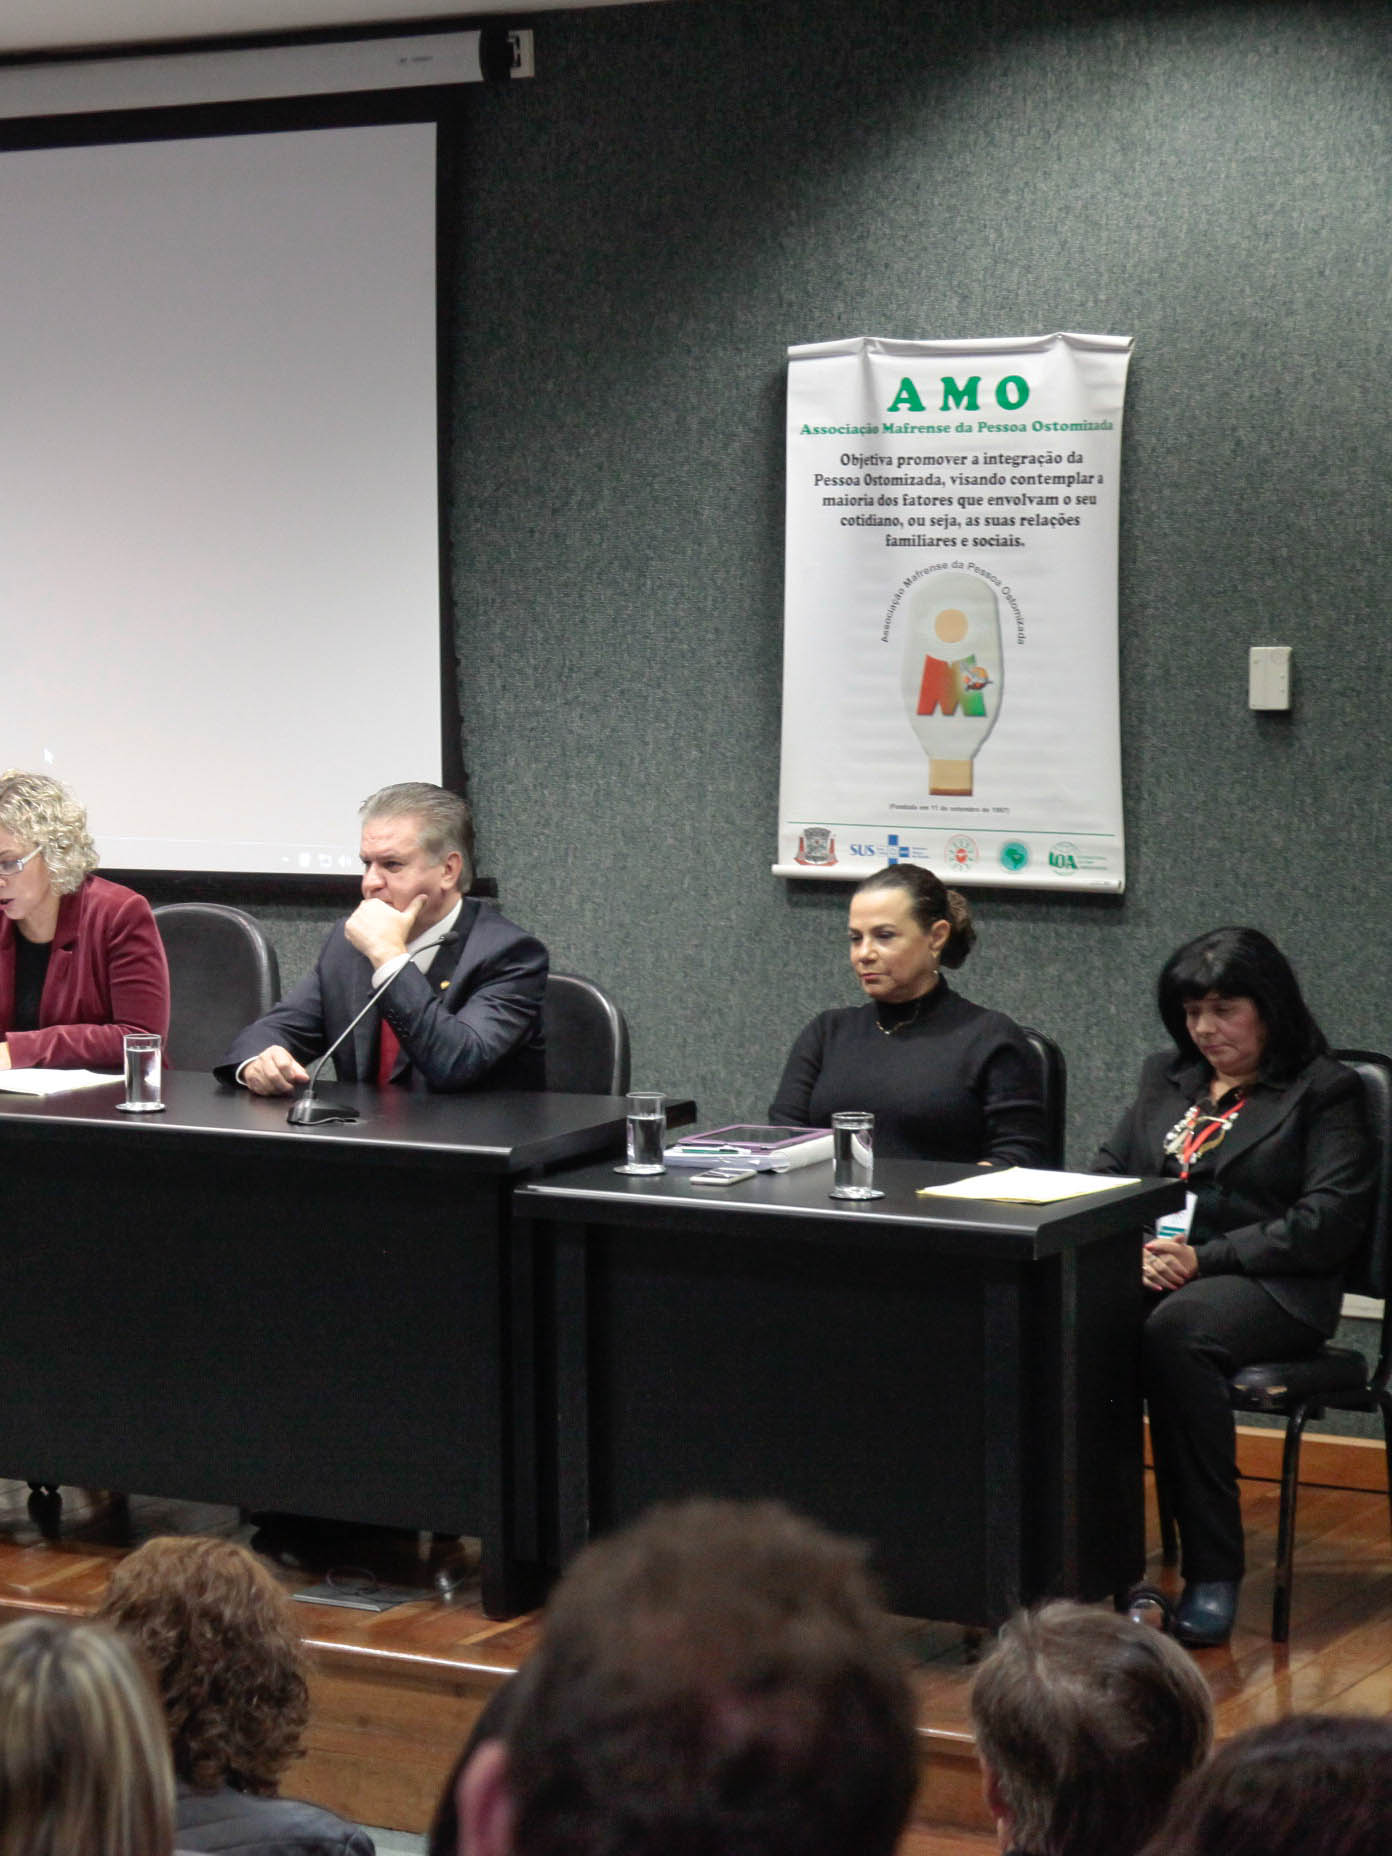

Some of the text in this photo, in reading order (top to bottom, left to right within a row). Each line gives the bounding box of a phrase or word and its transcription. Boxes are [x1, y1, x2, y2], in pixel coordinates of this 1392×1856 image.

[800, 418, 1114, 437] Associação Mafrense da Pessoa Ostomizada
[840, 450, 1084, 469] Objetiva promover a integração da
[813, 471, 1105, 488] Pessoa Ostomizada, visando contemplar a
[821, 492, 1098, 510] maioria dos fatores que envolvam o seu
[839, 513, 1081, 530] cotidiano, ou seja, as suas relações
[884, 533, 1026, 548] familiares e sociais.
[902, 562, 949, 589] Mafrense
[951, 560, 965, 570] da
[967, 561, 1003, 587] Pessoa
[1001, 586, 1027, 645] Ostomizada
[848, 842, 876, 857] SUS
